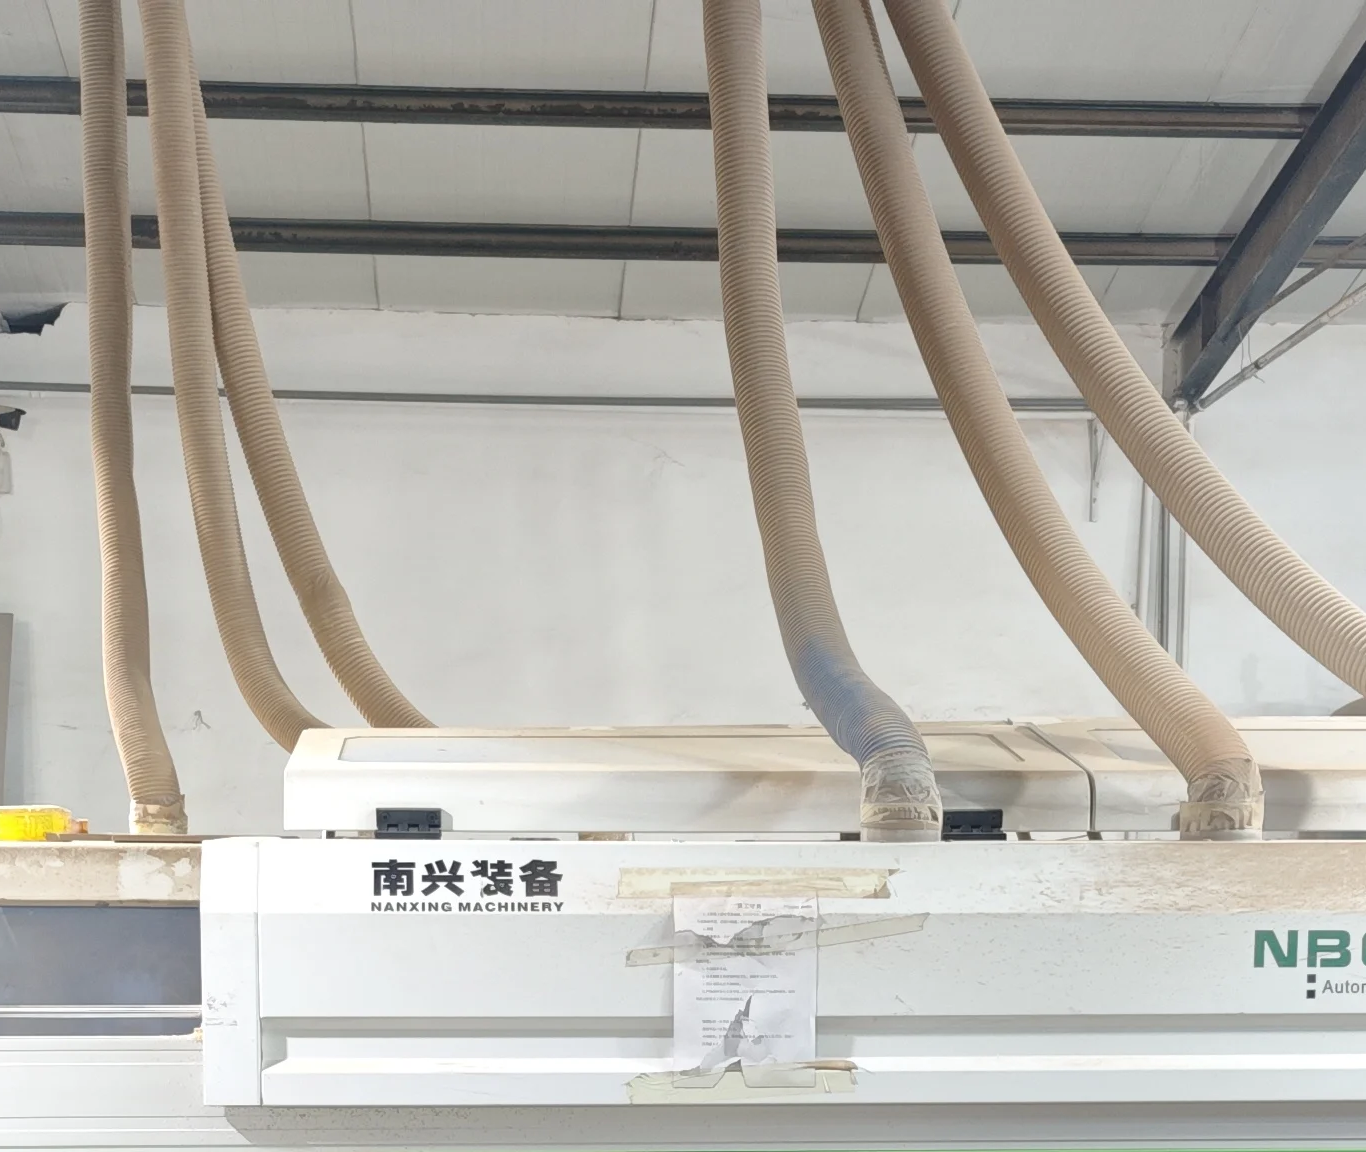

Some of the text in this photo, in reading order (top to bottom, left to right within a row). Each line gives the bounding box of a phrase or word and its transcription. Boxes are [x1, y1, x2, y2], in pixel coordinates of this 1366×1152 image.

[372, 859, 563, 897] 南兴装备
[371, 902, 564, 912] NANXING MACHINERY
